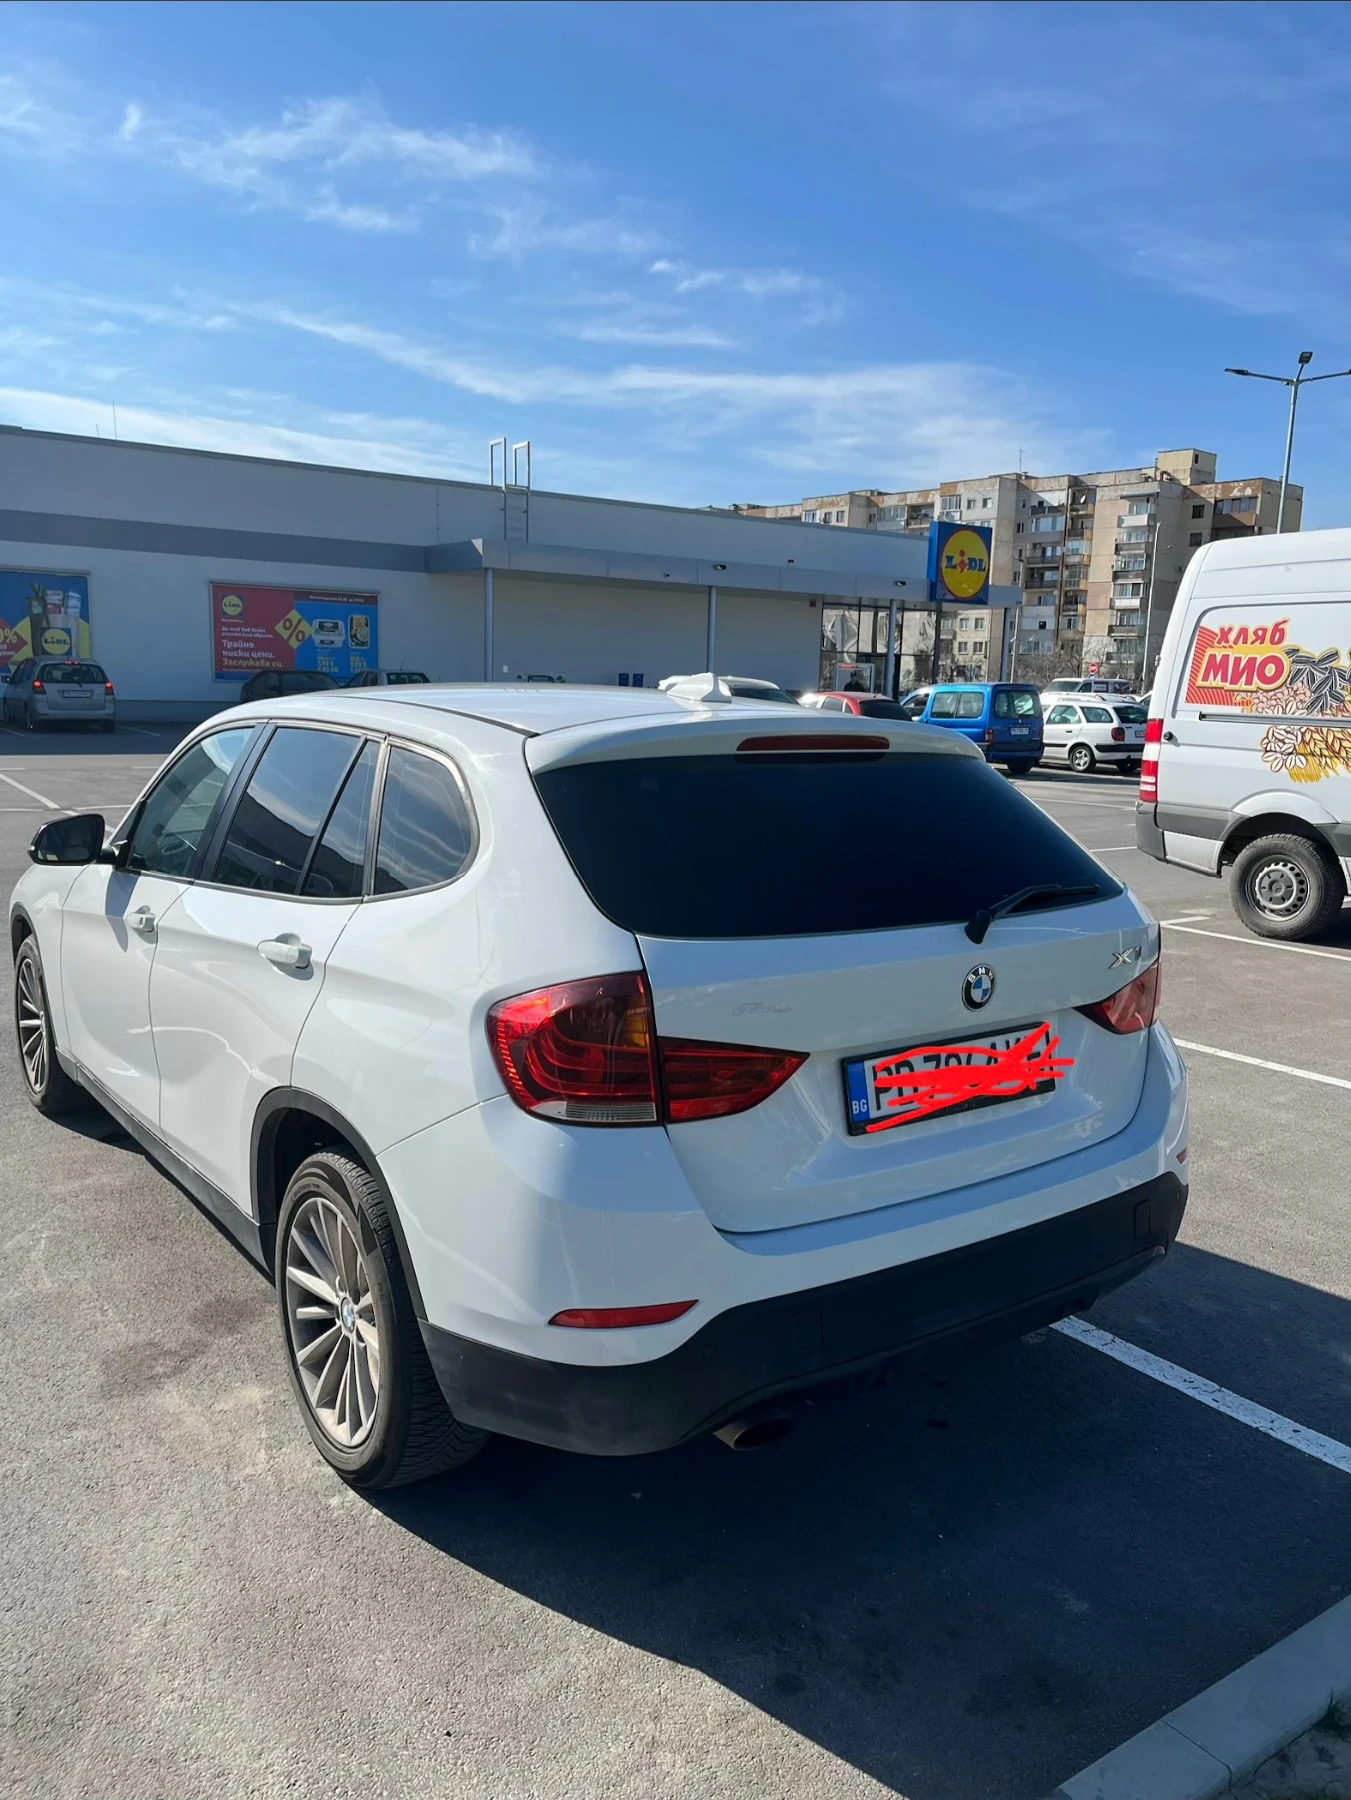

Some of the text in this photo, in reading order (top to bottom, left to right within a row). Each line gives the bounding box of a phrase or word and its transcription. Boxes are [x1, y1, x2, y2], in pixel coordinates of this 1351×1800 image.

[222, 640, 255, 649] Трайно
[222, 658, 270, 667] Заслужава
[1199, 652, 1287, 687] МИО
[851, 1098, 868, 1115] BG
